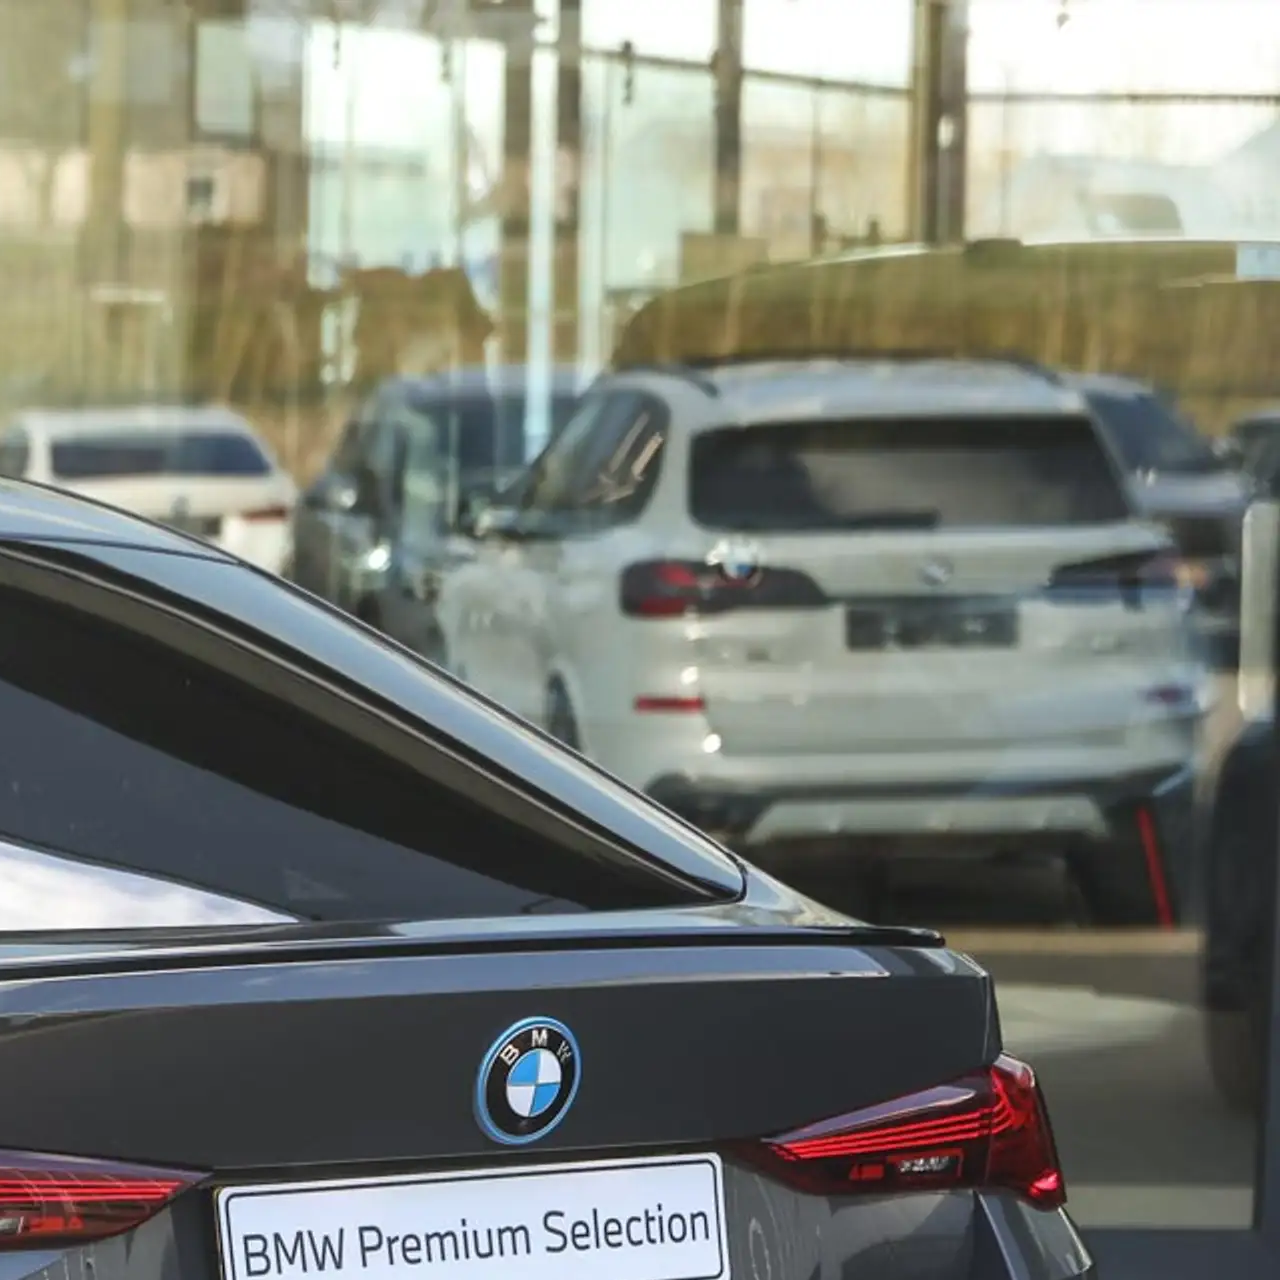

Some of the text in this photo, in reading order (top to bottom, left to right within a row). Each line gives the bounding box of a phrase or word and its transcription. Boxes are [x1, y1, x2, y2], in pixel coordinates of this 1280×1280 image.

[500, 1029, 572, 1066] BMW
[243, 1203, 709, 1277] BMW Premium Selection
